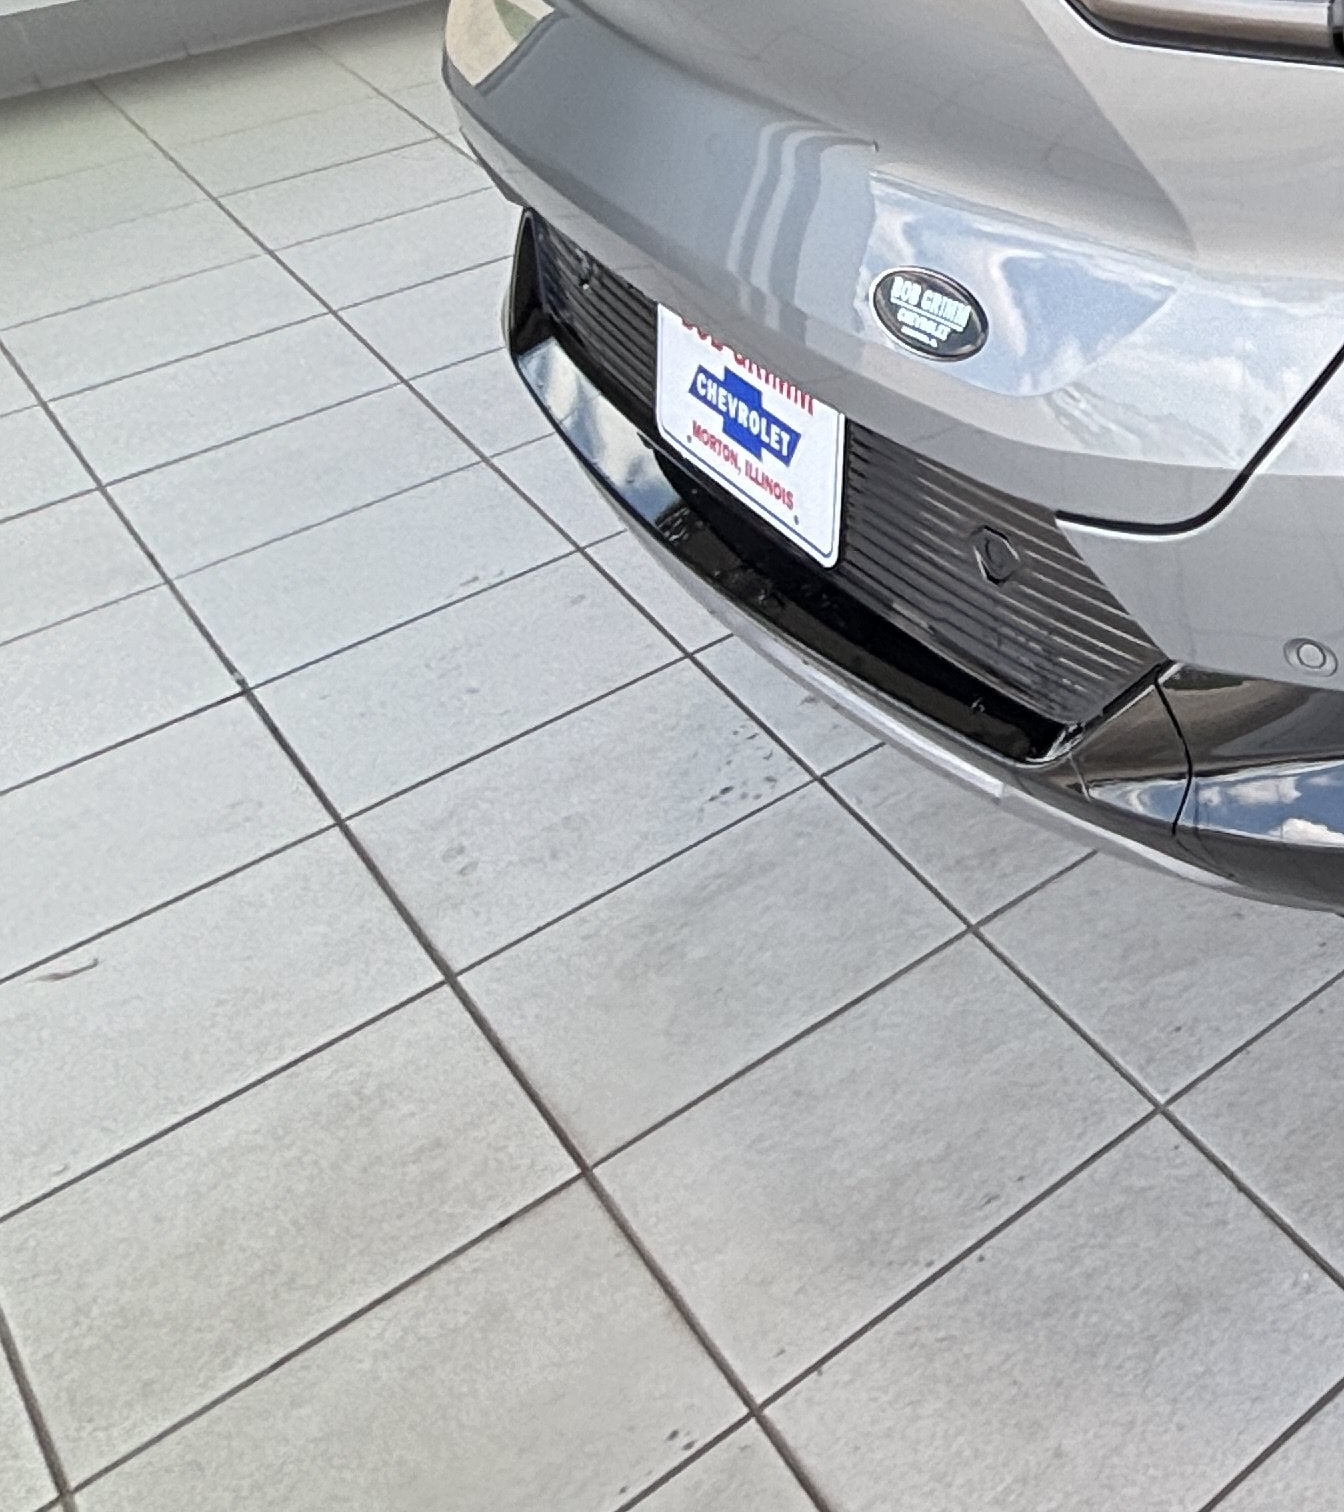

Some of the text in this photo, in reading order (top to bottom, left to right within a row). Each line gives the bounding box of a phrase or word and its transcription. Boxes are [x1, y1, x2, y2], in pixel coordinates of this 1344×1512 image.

[891, 276, 972, 328] BOB GRIMM
[696, 372, 791, 457] CHEVROLET
[692, 419, 794, 510] MORTON, ILLINOIS
